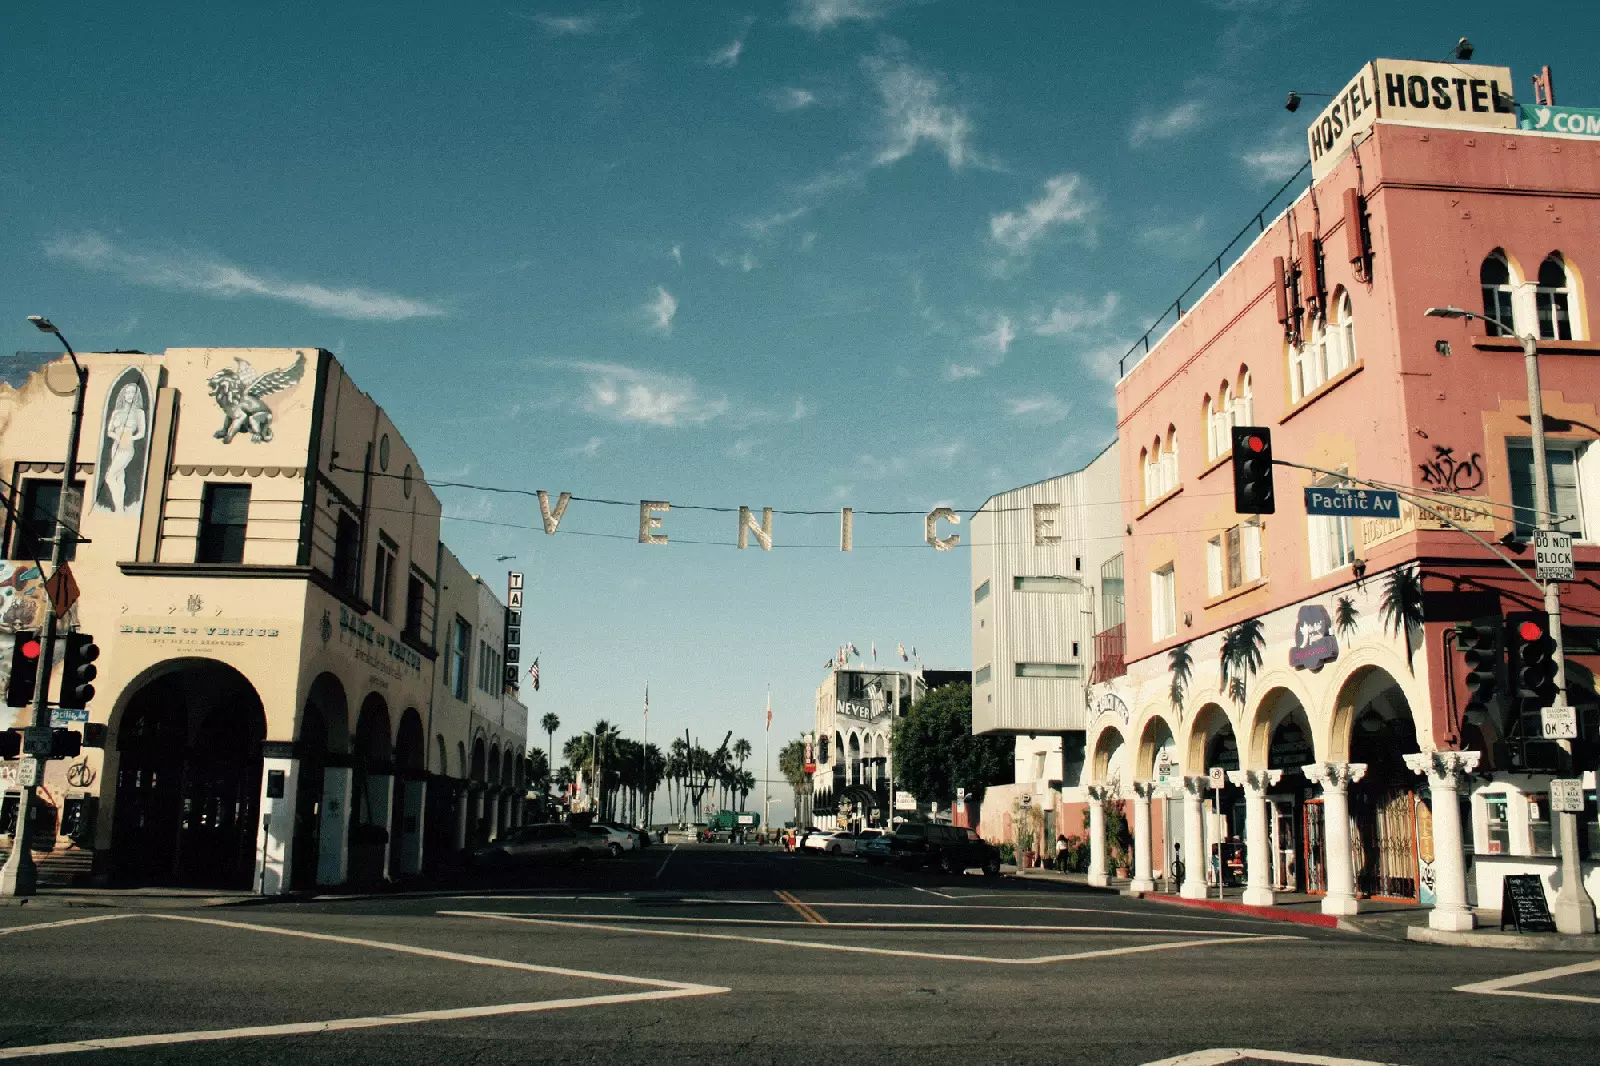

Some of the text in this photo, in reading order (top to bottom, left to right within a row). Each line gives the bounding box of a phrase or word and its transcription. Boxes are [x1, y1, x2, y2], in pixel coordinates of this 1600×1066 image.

[1385, 72, 1511, 113] HOSTEL
[1311, 75, 1372, 162] HOSTEL
[1311, 493, 1393, 511] Pacific Av
[536, 490, 1062, 552] VENICE
[1536, 537, 1569, 548] DO NOT
[1537, 552, 1572, 564] BLOCK
[506, 573, 523, 683] TATTOO
[836, 698, 870, 720] NEVER
[1544, 722, 1558, 735] OK
